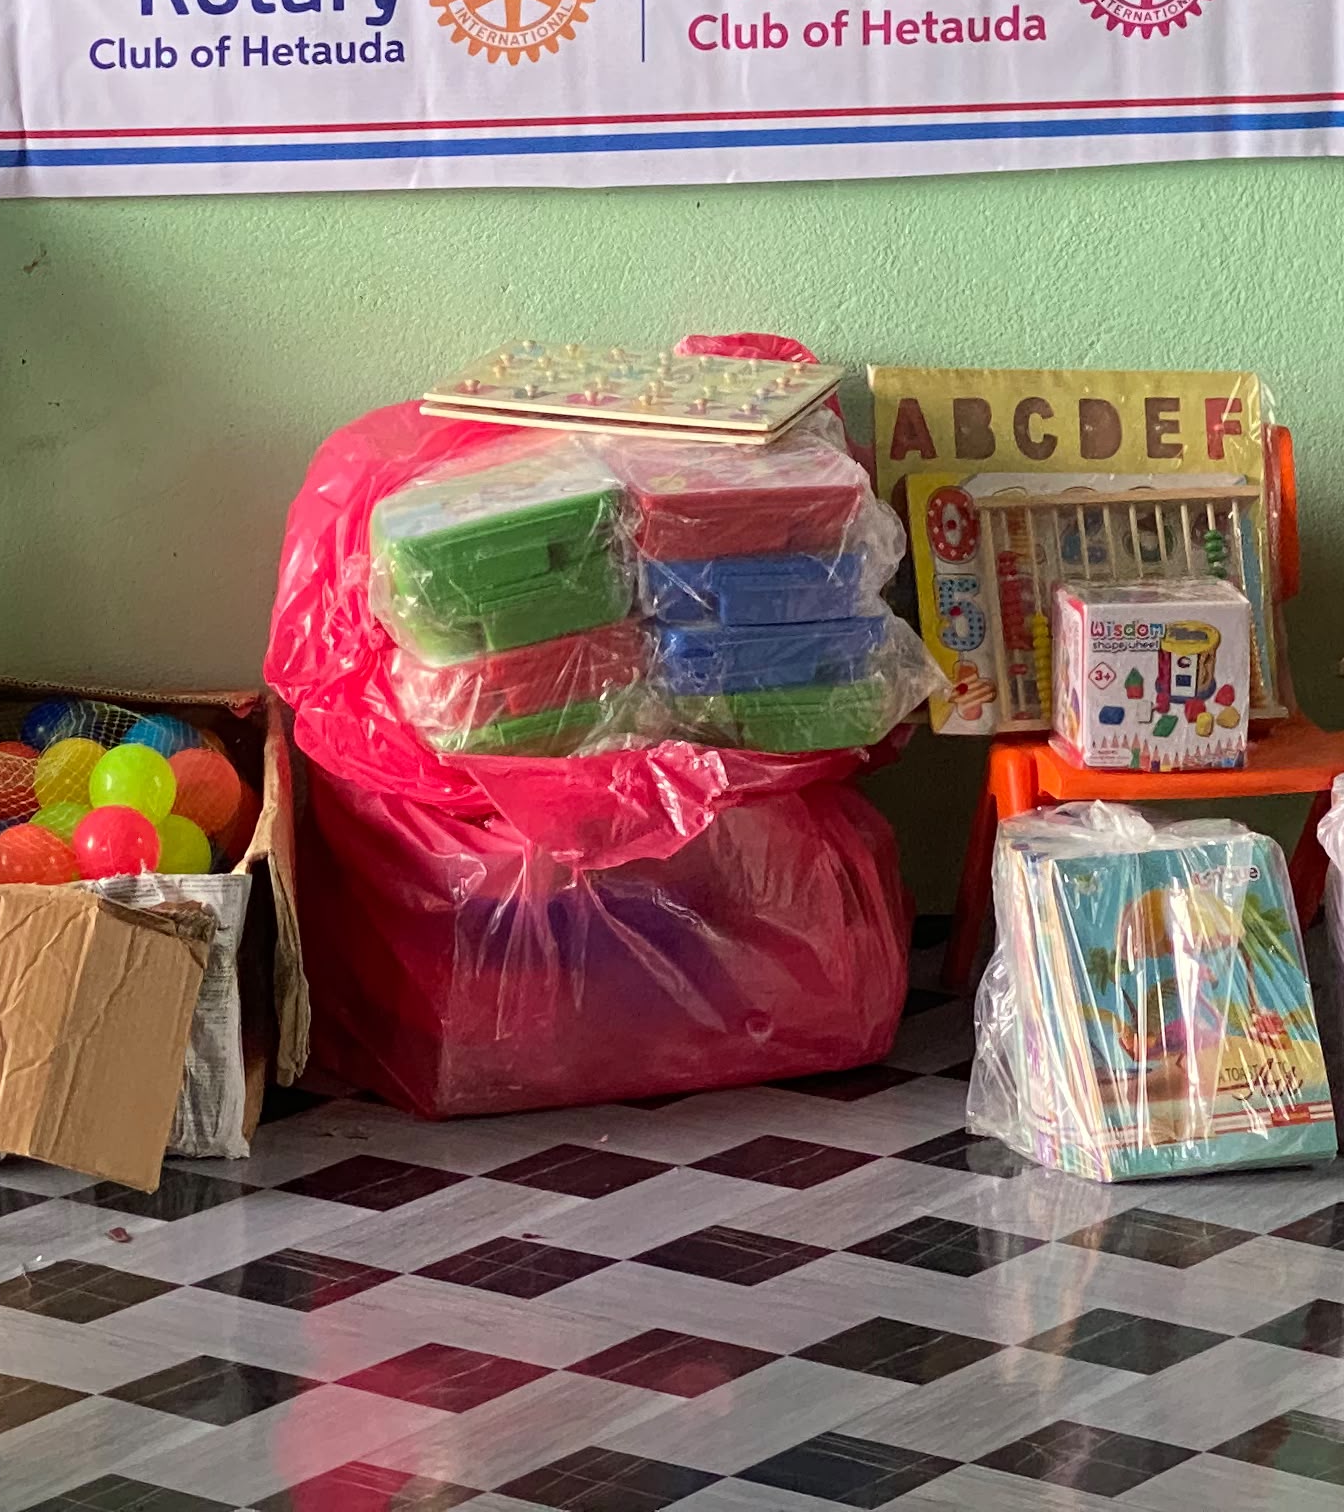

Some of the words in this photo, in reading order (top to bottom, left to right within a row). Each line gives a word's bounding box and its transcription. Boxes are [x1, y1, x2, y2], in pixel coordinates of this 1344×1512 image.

[455, 3, 573, 46] INTERNATIONAL
[688, 12, 789, 51] Club
[803, 9, 850, 48] of
[861, 5, 1048, 45] Hetauda
[89, 38, 178, 70] Club
[190, 36, 232, 68] of
[242, 32, 406, 68] Hetauda
[889, 398, 937, 460] A
[953, 397, 996, 460] B
[1013, 397, 1058, 460] C
[1078, 398, 1123, 460] D
[1144, 397, 1183, 459] E
[1204, 398, 1243, 460] F
[1094, 670, 1111, 682] 3+
